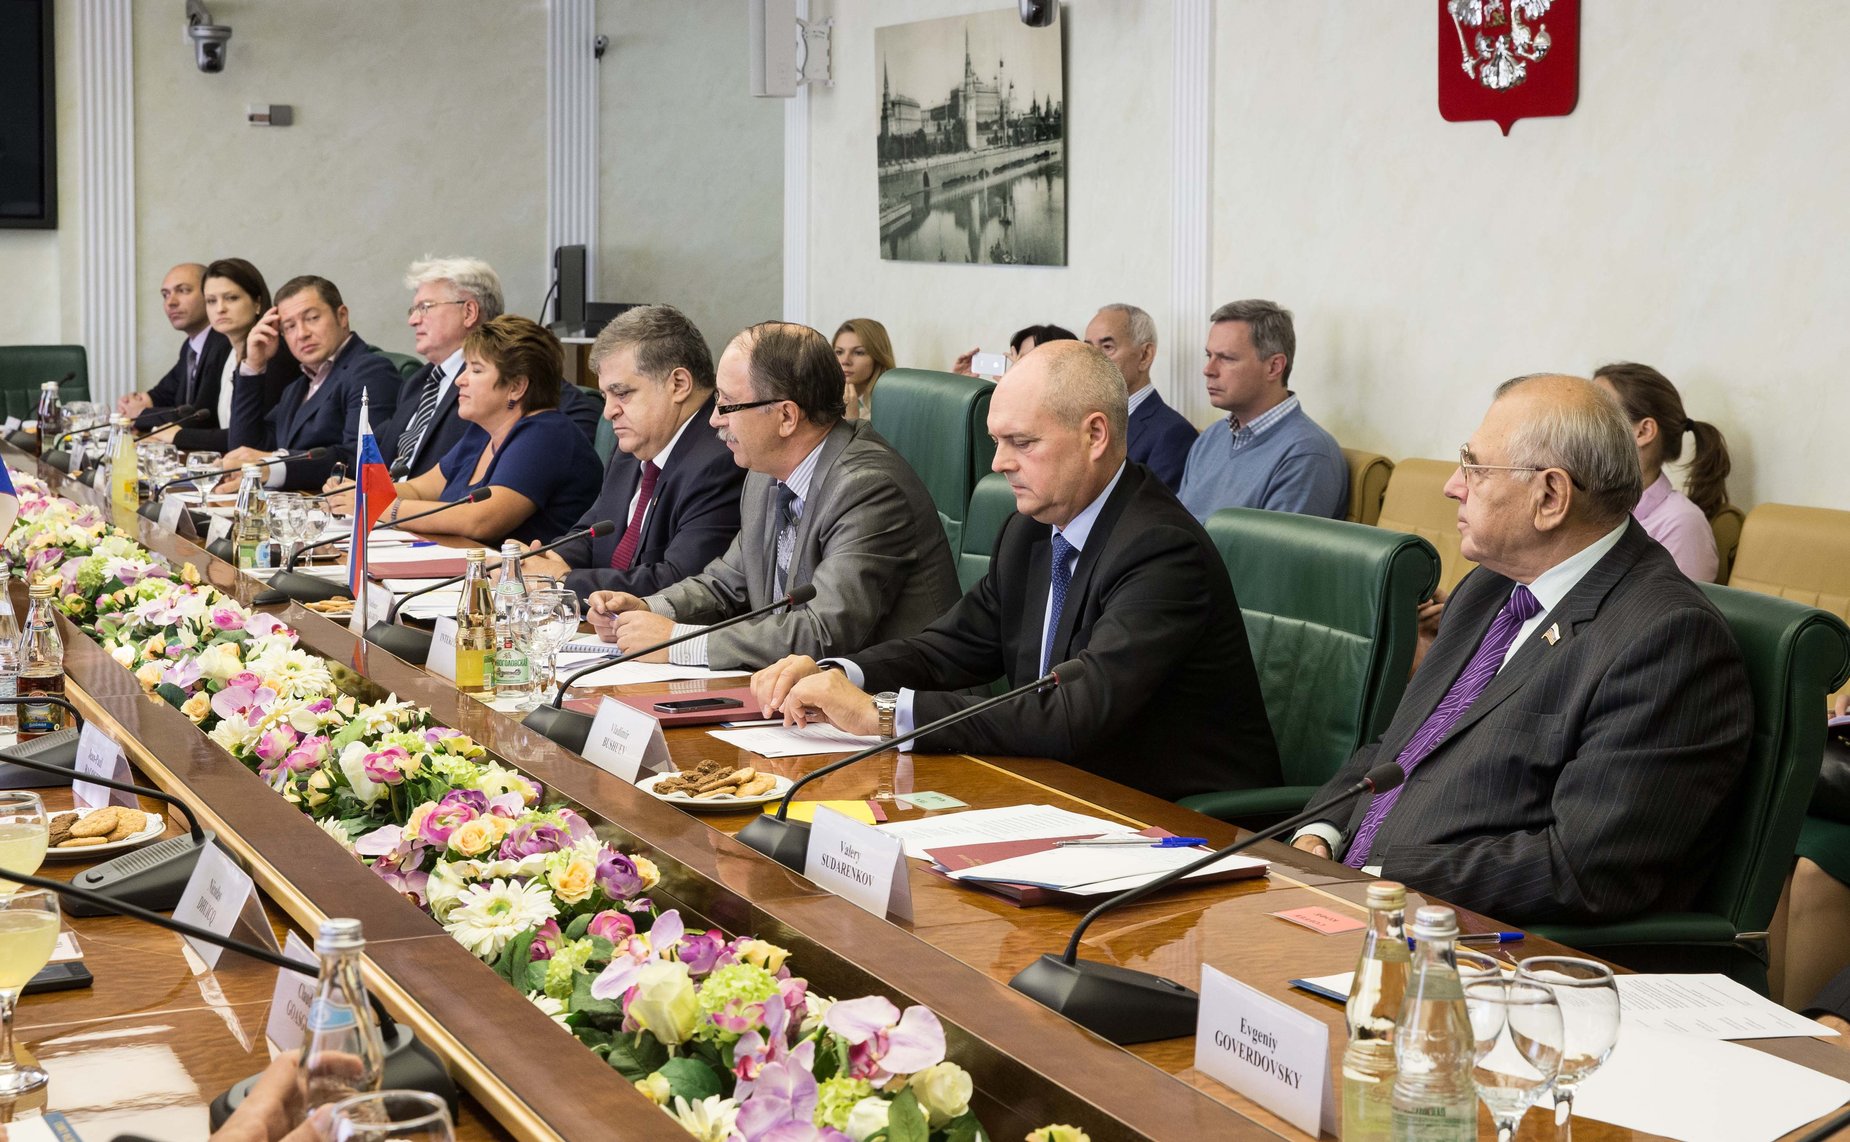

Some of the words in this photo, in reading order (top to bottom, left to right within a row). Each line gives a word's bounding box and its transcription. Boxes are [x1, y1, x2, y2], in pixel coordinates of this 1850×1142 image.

[610, 721, 631, 740] Vladimir
[840, 840, 861, 864] Valery
[820, 853, 875, 887] SUDARENKOV
[298, 983, 314, 1009] Claud
[1240, 1017, 1278, 1054] Evgeniy
[1214, 1029, 1303, 1089] GOVERDOVSKY
